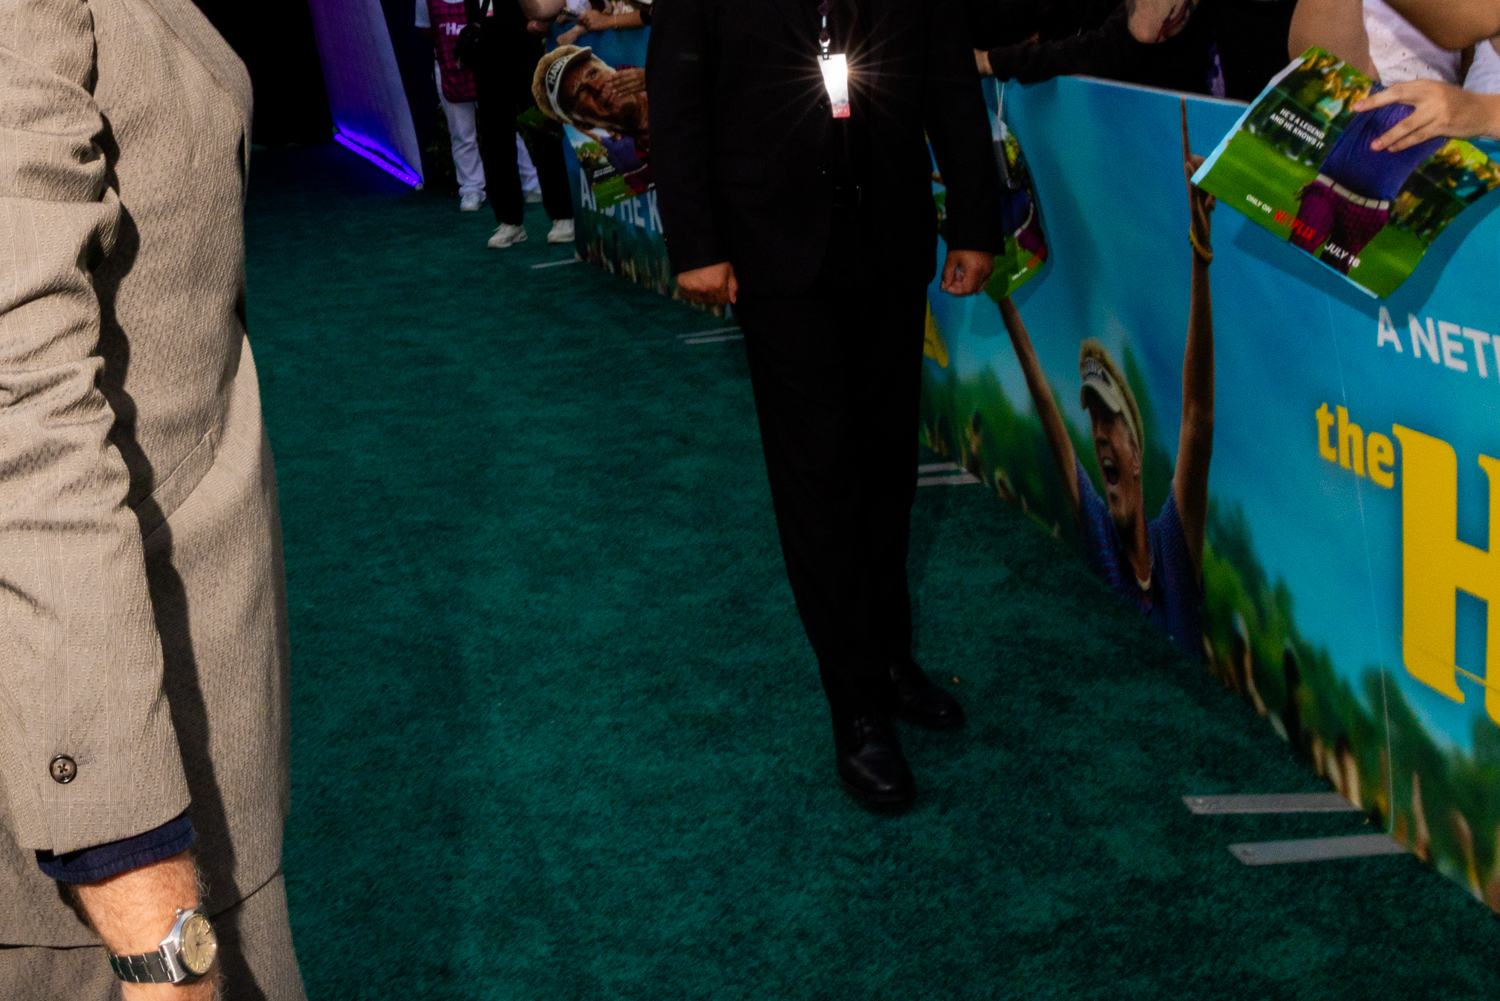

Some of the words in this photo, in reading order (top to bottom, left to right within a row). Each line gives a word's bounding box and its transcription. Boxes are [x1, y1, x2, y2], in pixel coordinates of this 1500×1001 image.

[1269, 113, 1284, 126] AND
[1282, 121, 1293, 132] HE
[1292, 126, 1316, 146] KNOWS
[1315, 139, 1326, 150] IT
[1293, 116, 1301, 124] A
[1299, 118, 1325, 140] LEGEND
[1246, 194, 1264, 207] ONLY
[1261, 203, 1273, 214] ON
[1273, 209, 1317, 241] NETFLIX
[1324, 242, 1349, 260] JULY
[1348, 254, 1361, 268] 16
[1376, 305, 1404, 353] A
[1315, 402, 1395, 490] the
